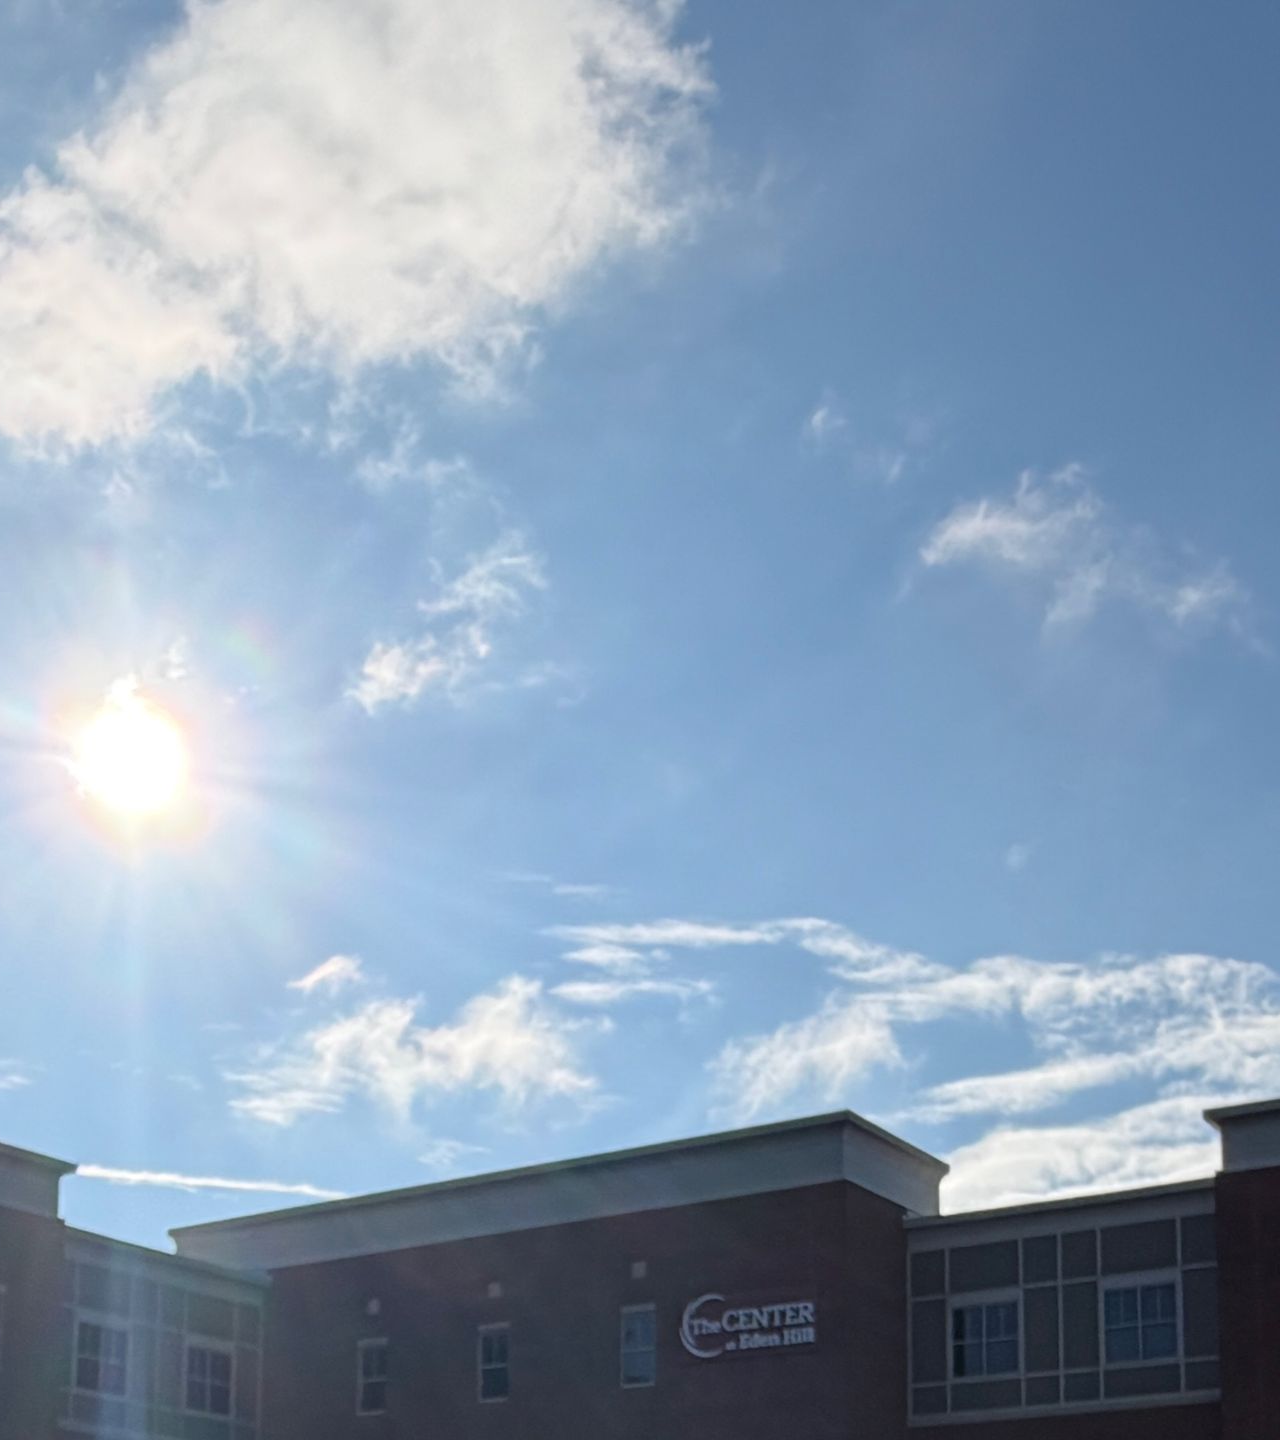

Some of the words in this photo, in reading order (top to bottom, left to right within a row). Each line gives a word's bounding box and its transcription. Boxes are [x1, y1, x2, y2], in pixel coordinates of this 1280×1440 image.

[692, 1317, 721, 1335] The
[722, 1302, 815, 1331] CENTER
[739, 1333, 781, 1349] Eden
